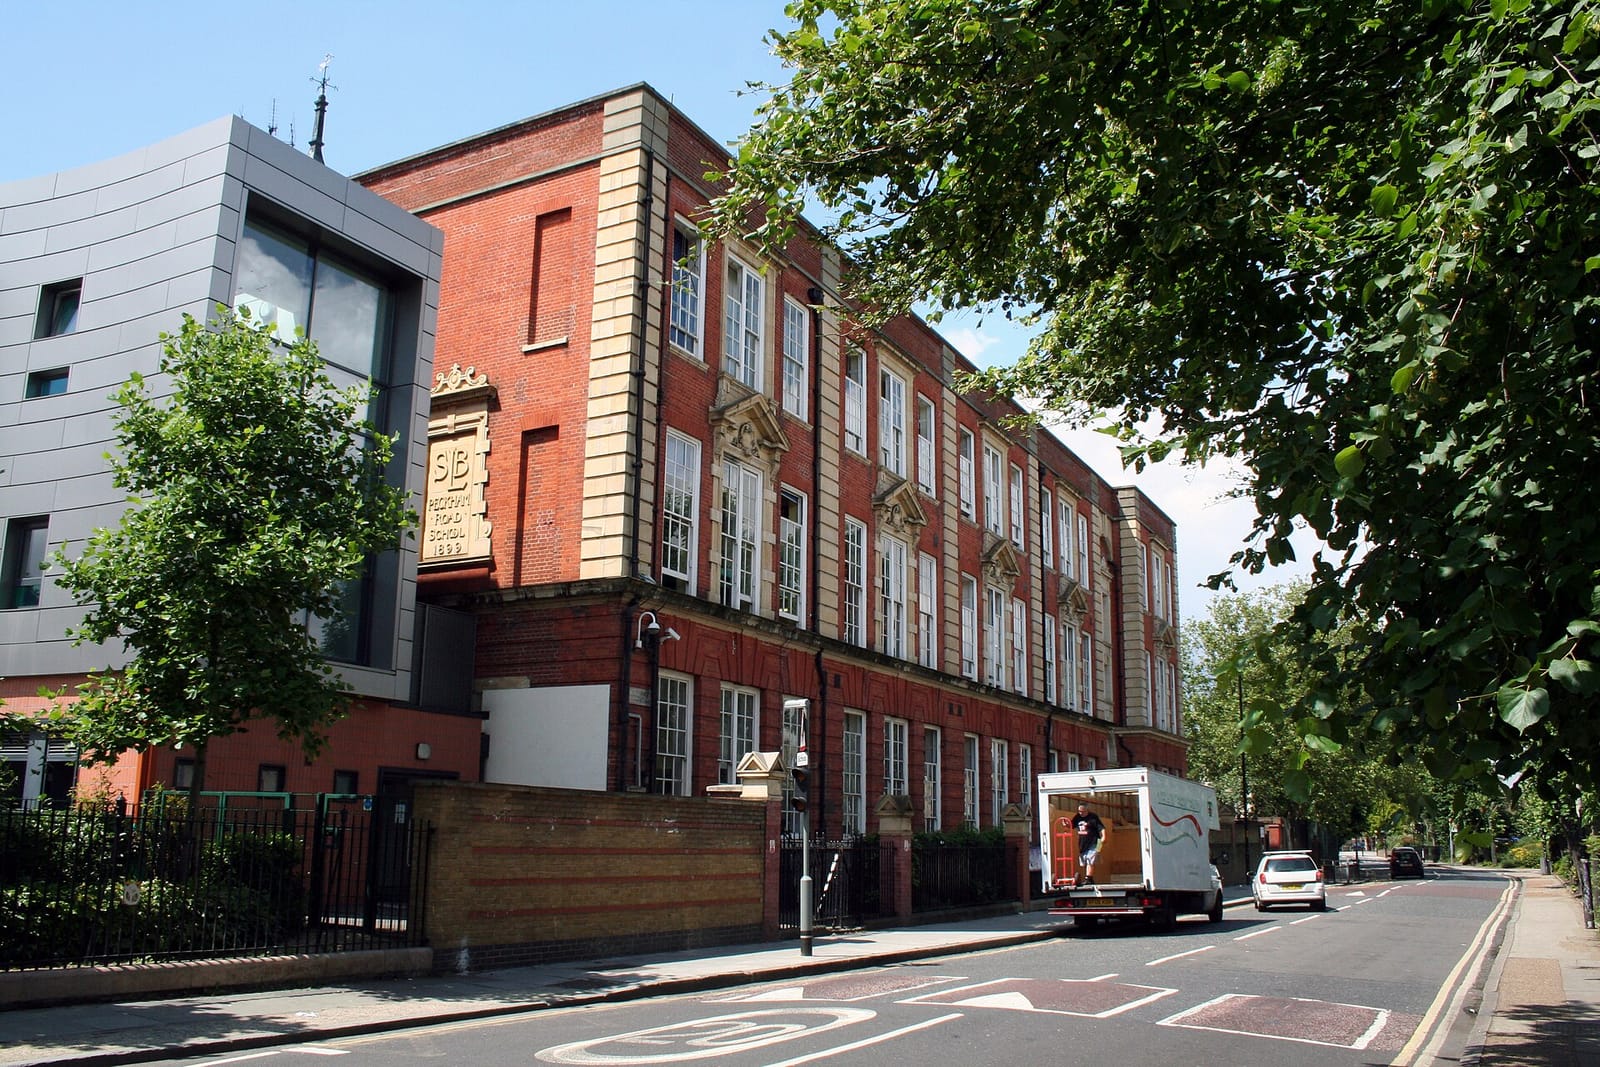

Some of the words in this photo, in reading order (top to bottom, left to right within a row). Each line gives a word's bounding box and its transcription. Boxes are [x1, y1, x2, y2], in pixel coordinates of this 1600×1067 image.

[428, 495, 470, 511] PECKHAM
[434, 512, 462, 526] ROAD
[434, 542, 462, 556] 1899
